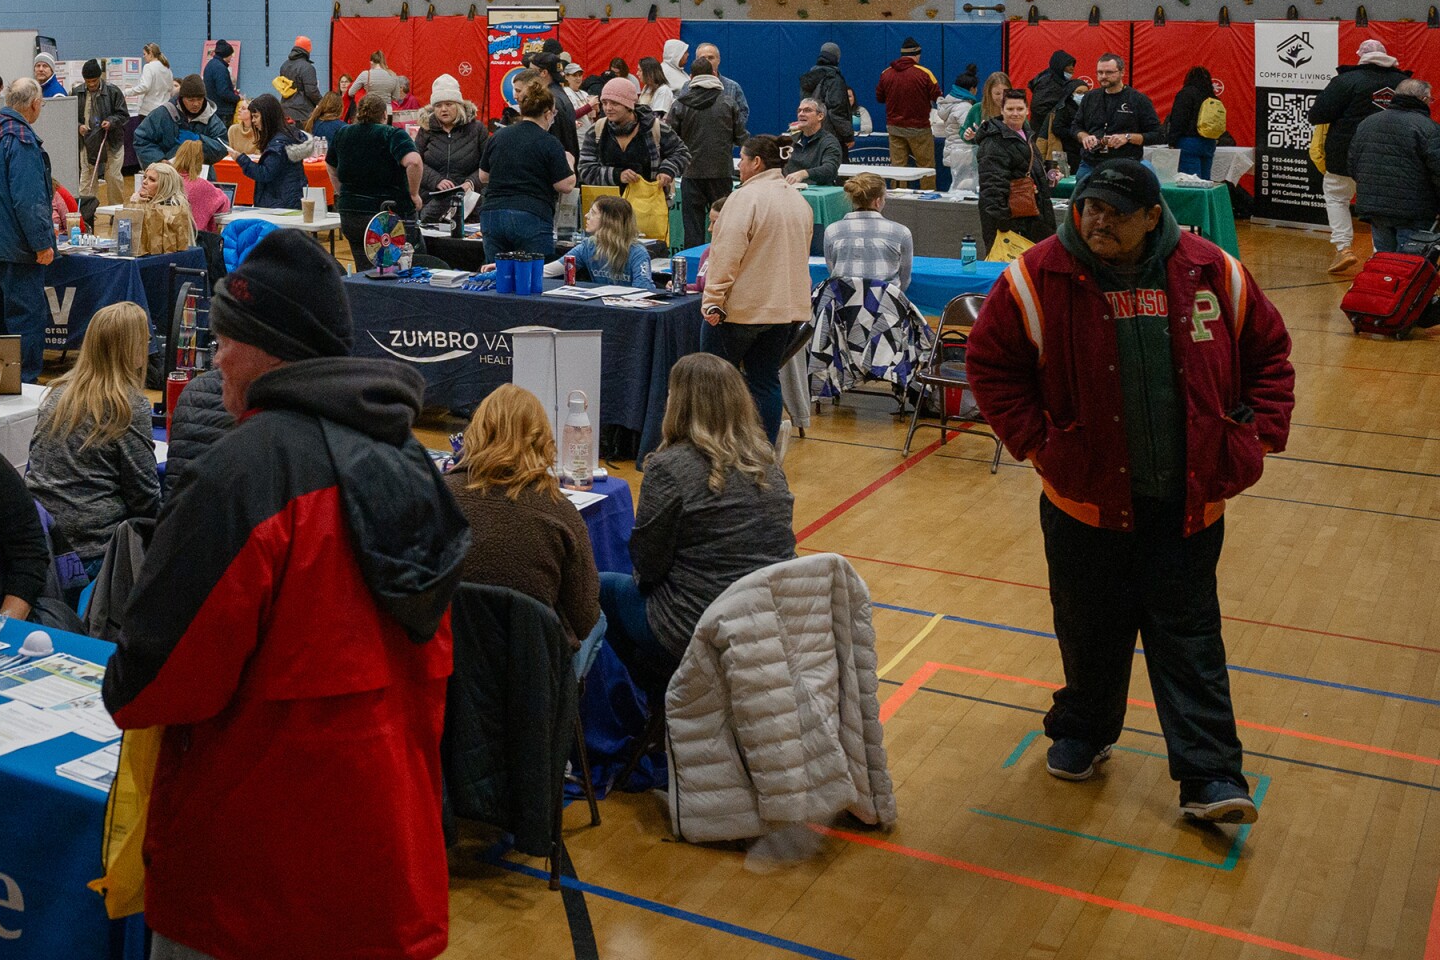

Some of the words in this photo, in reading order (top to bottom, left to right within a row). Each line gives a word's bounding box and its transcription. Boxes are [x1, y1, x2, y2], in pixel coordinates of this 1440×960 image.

[1259, 71, 1298, 79] COMFORT
[1300, 73, 1332, 81] LIVINGS
[1190, 290, 1222, 343] P
[45, 326, 69, 335] eran
[45, 336, 67, 345] ness
[389, 330, 479, 350] ZUMBRO
[482, 332, 510, 352] VA
